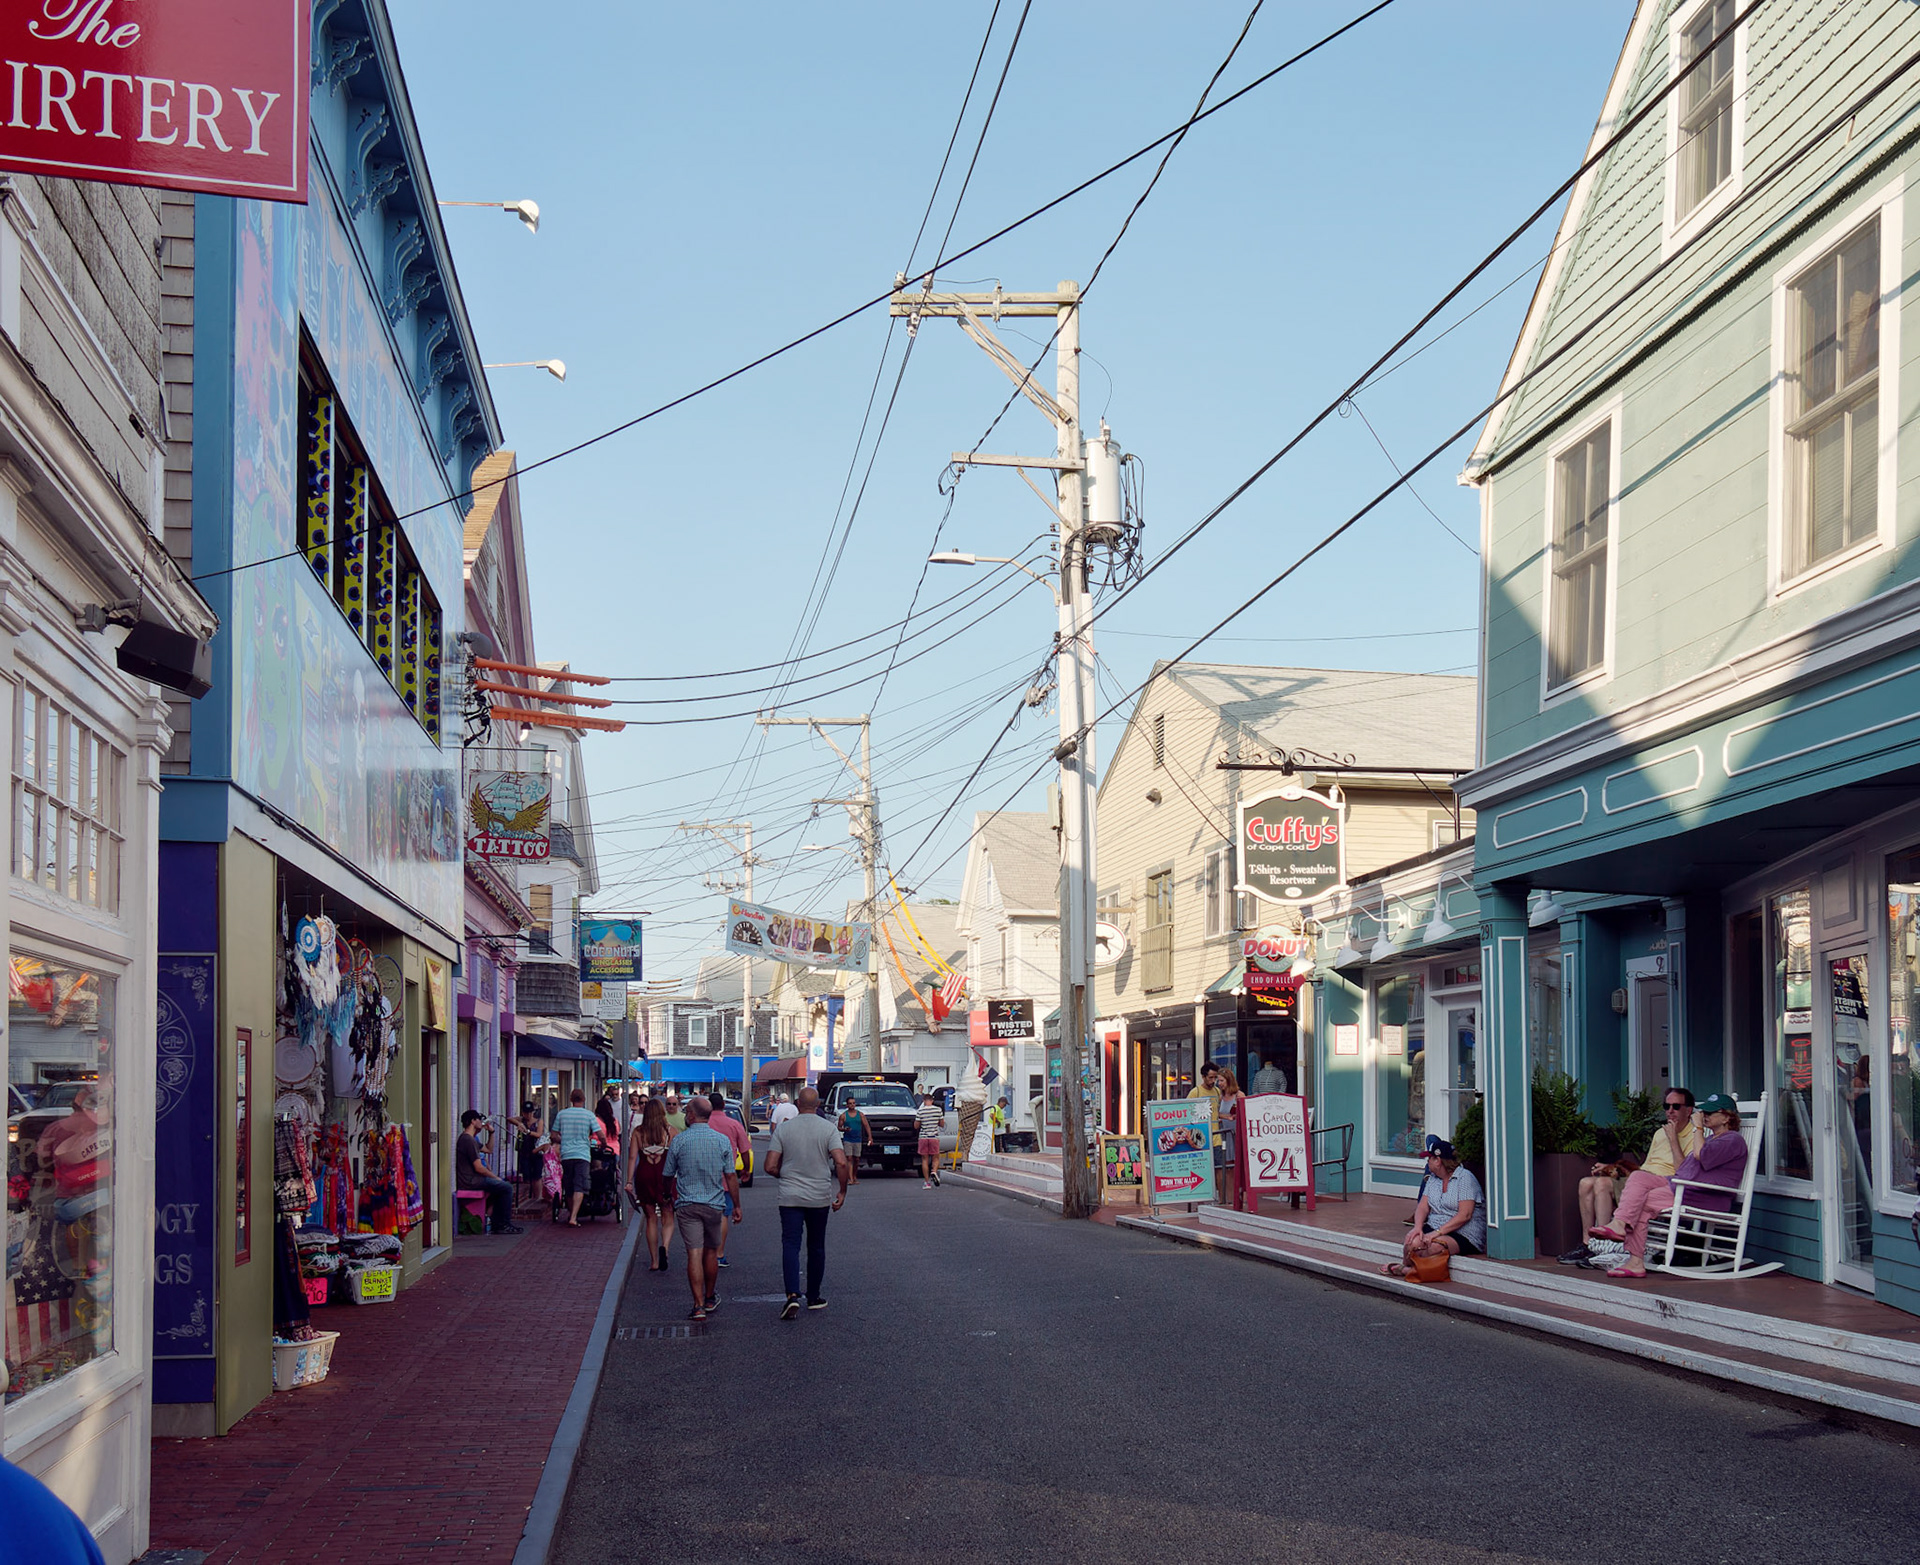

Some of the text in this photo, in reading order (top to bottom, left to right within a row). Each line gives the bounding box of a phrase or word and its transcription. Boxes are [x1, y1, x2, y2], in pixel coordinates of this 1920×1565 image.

[28, 0, 141, 48] The
[0, 60, 281, 156] IRTERY
[1246, 816, 1339, 850] Cuffy's
[474, 838, 548, 857] TATTOO
[1259, 844, 1284, 852] Cape
[1248, 864, 1337, 875] T-Shirts Sweatshirts
[1269, 875, 1317, 885] Resortwear
[1480, 924, 1494, 941] 291
[583, 945, 640, 958] COCONUTS
[1242, 938, 1309, 957] DONUT
[1251, 976, 1264, 984] END
[1266, 976, 1273, 984] OF
[602, 991, 623, 999] AMILY
[991, 1020, 1033, 1030] TWISTED
[998, 1029, 1027, 1037] PIZZA
[1154, 1109, 1187, 1121] DONUT
[1248, 1119, 1303, 1138] HOODIES
[81, 1142, 98, 1158] CAPE
[1106, 1145, 1141, 1163] BAR
[1107, 1162, 1142, 1178] OPEN
